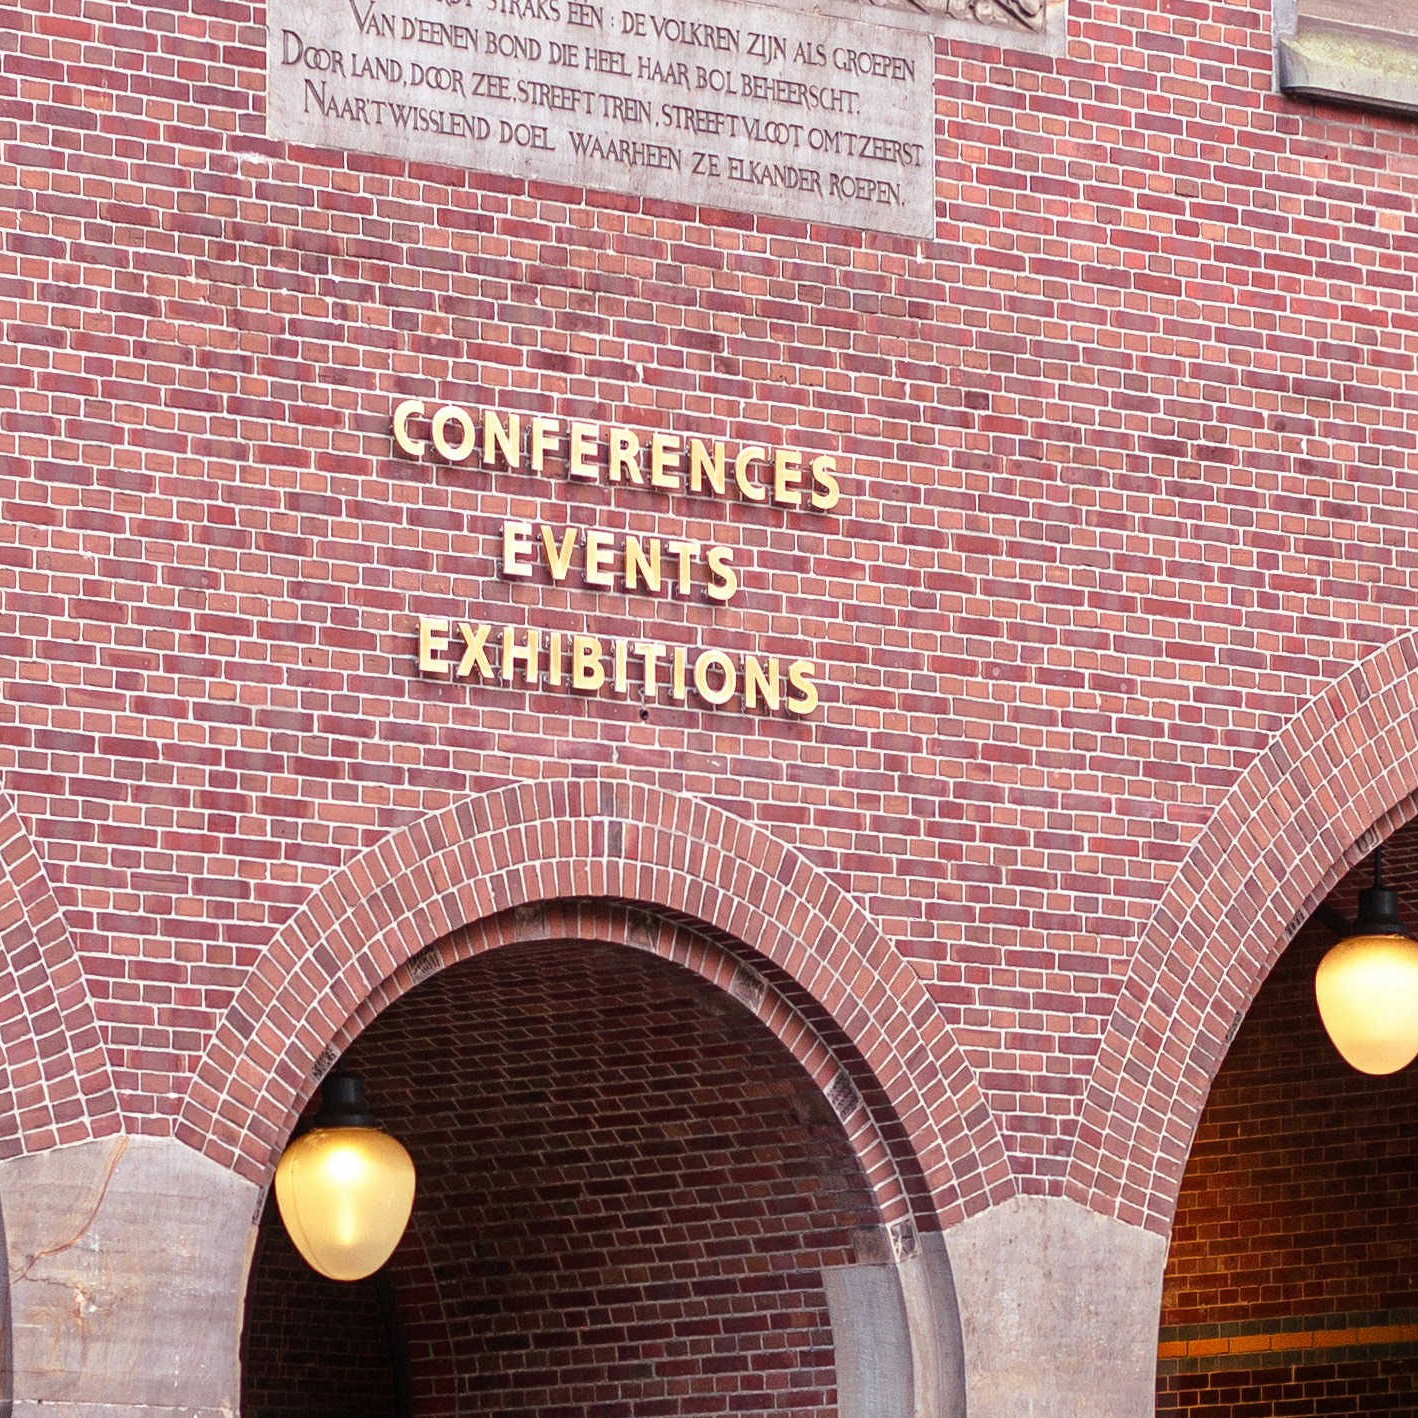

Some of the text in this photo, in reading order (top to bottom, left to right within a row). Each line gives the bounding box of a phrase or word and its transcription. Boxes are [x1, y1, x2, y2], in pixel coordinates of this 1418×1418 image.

[349, 0, 396, 39] VAN
[485, 31, 542, 61] BOND
[549, 41, 579, 68] DIE
[585, 47, 631, 77] HEEL
[637, 56, 691, 90] HAAR
[695, 66, 738, 95] BOL
[741, 73, 861, 115] BEHEERSCHT.
[622, 10, 647, 37] DE
[650, 16, 739, 53] VOLKREN
[746, 32, 786, 64] ZIJN
[793, 41, 827, 67] ALS
[833, 47, 915, 82] GROEPEN
[281, 29, 346, 78] DOOR
[351, 53, 408, 88] LAND,
[410, 62, 466, 99] DOOR
[517, 79, 595, 115] STREEFT
[661, 103, 740, 137] STREEFT
[741, 117, 804, 148] VLOOT
[858, 135, 924, 168] ZEERST
[382, 103, 490, 141] WISSLEND
[499, 119, 556, 151] DOEL
[568, 131, 681, 170] WAARHEEN
[692, 152, 720, 177] ZE
[728, 157, 823, 196] ELKANDER
[829, 173, 905, 206] ROEPEN.
[392, 400, 840, 510] CONFERENCES
[501, 521, 738, 601] EVENTS
[419, 616, 820, 714] EXHIBITIONS
